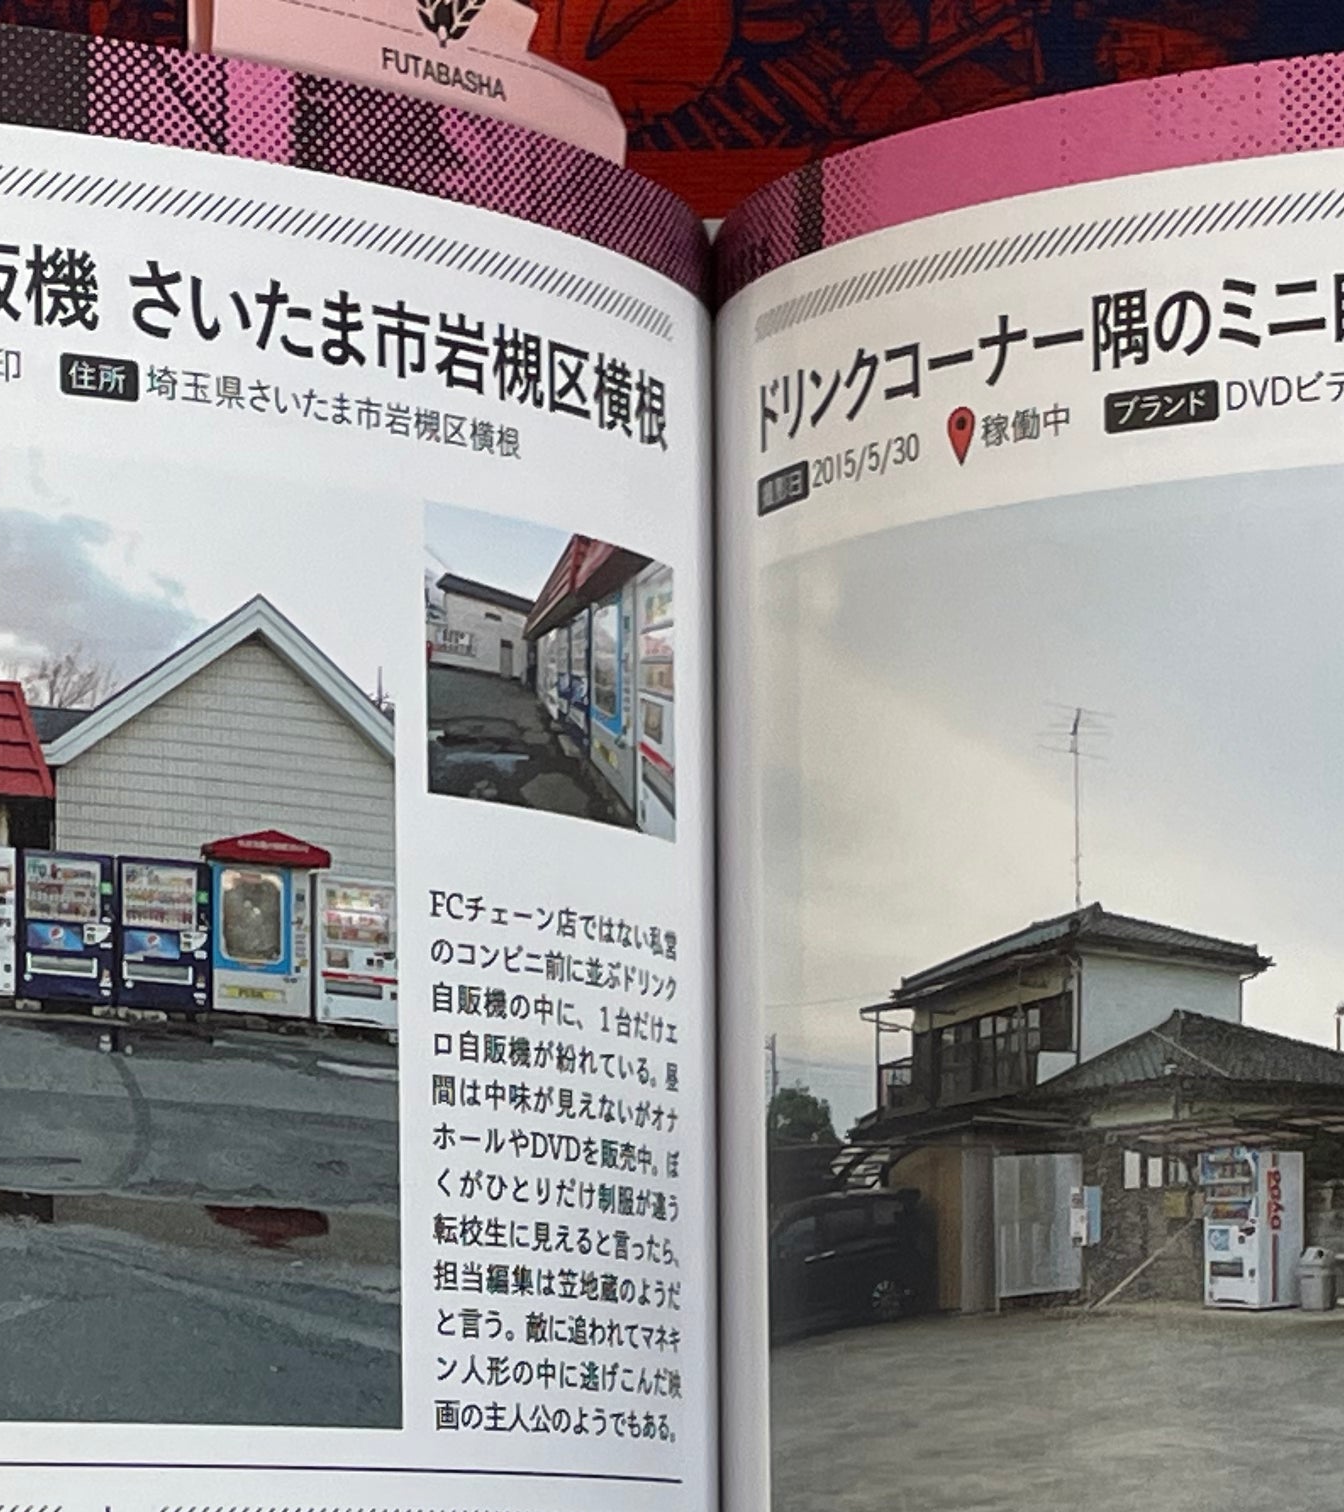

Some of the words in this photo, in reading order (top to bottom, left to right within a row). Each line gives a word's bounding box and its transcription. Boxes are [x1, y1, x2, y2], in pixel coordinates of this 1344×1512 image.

[382, 46, 507, 101] FUTABASHA
[129, 259, 668, 450] さいたま市岩槻区横根
[67, 360, 127, 394] 住所
[146, 366, 522, 460] 埼玉県さいたま市岩槻区横根
[811, 432, 920, 488] 2015/5/30
[981, 403, 1070, 447] 稼働中
[1113, 393, 1206, 424] ブランド
[431, 939, 677, 1001] のコンビニ前に並ぶドリンク
[437, 1167, 679, 1222] くがひとりだけ制服が違う
[433, 1212, 680, 1267] 転校生に見えると言ったら、
[437, 1308, 681, 1352] と言う。敵に追われてマネキ
[435, 1399, 676, 1443] 画の主人公のようでもある。
